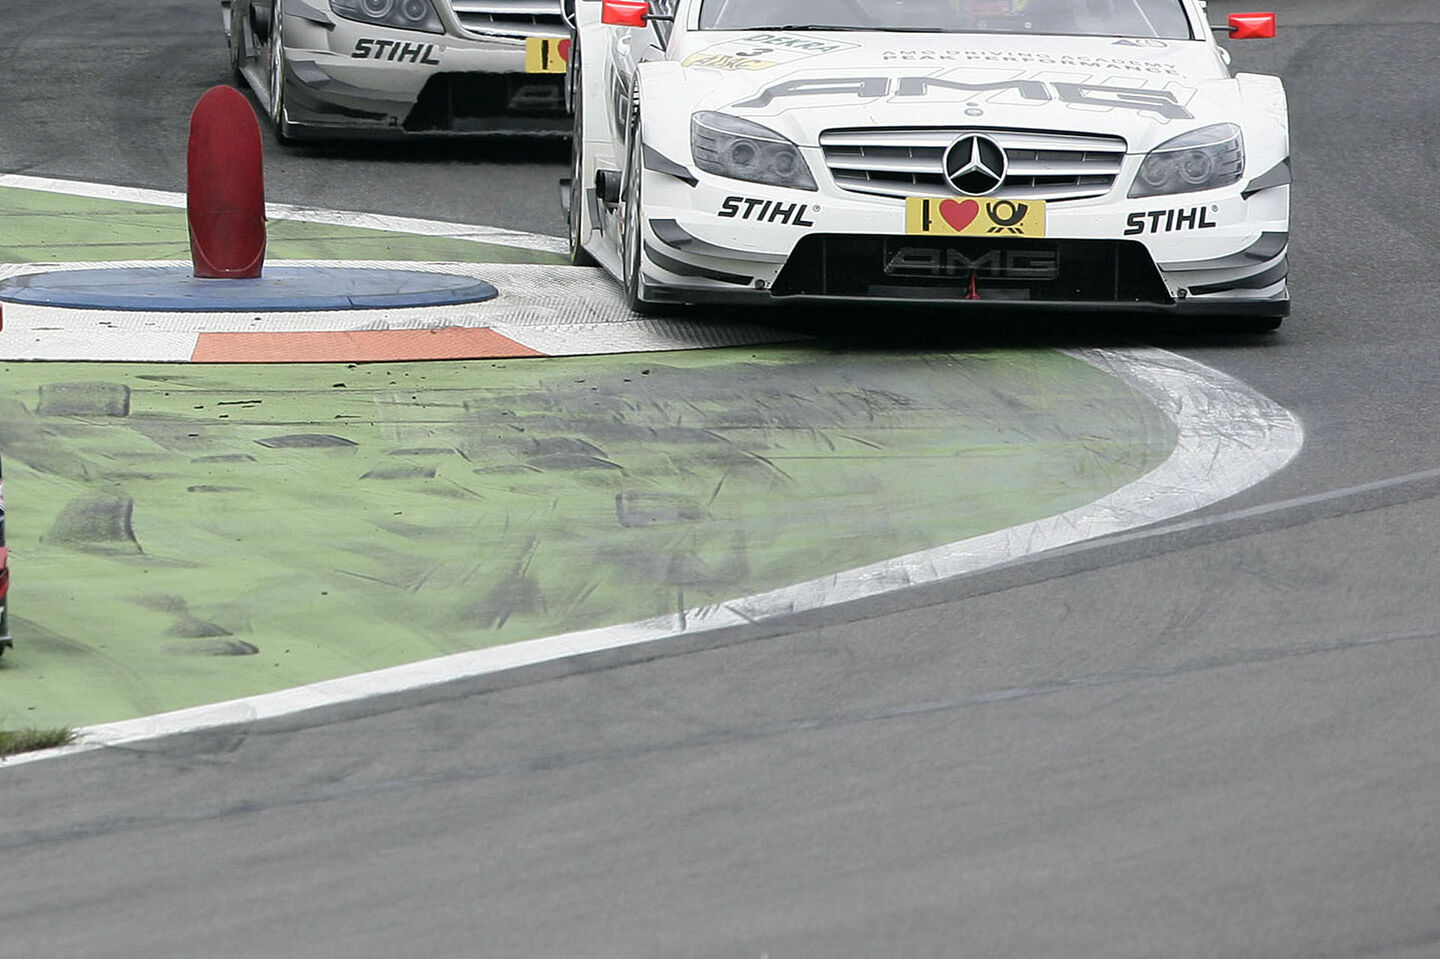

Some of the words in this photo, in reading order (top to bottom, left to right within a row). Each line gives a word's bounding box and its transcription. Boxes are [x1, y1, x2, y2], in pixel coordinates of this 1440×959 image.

[350, 38, 441, 65] STIHL
[735, 47, 775, 58] 3
[748, 34, 841, 54] DEKRA
[730, 75, 1197, 120] AMG
[717, 196, 815, 227] STIHL
[1123, 206, 1219, 237] STIHL
[885, 248, 1058, 278] AMG
